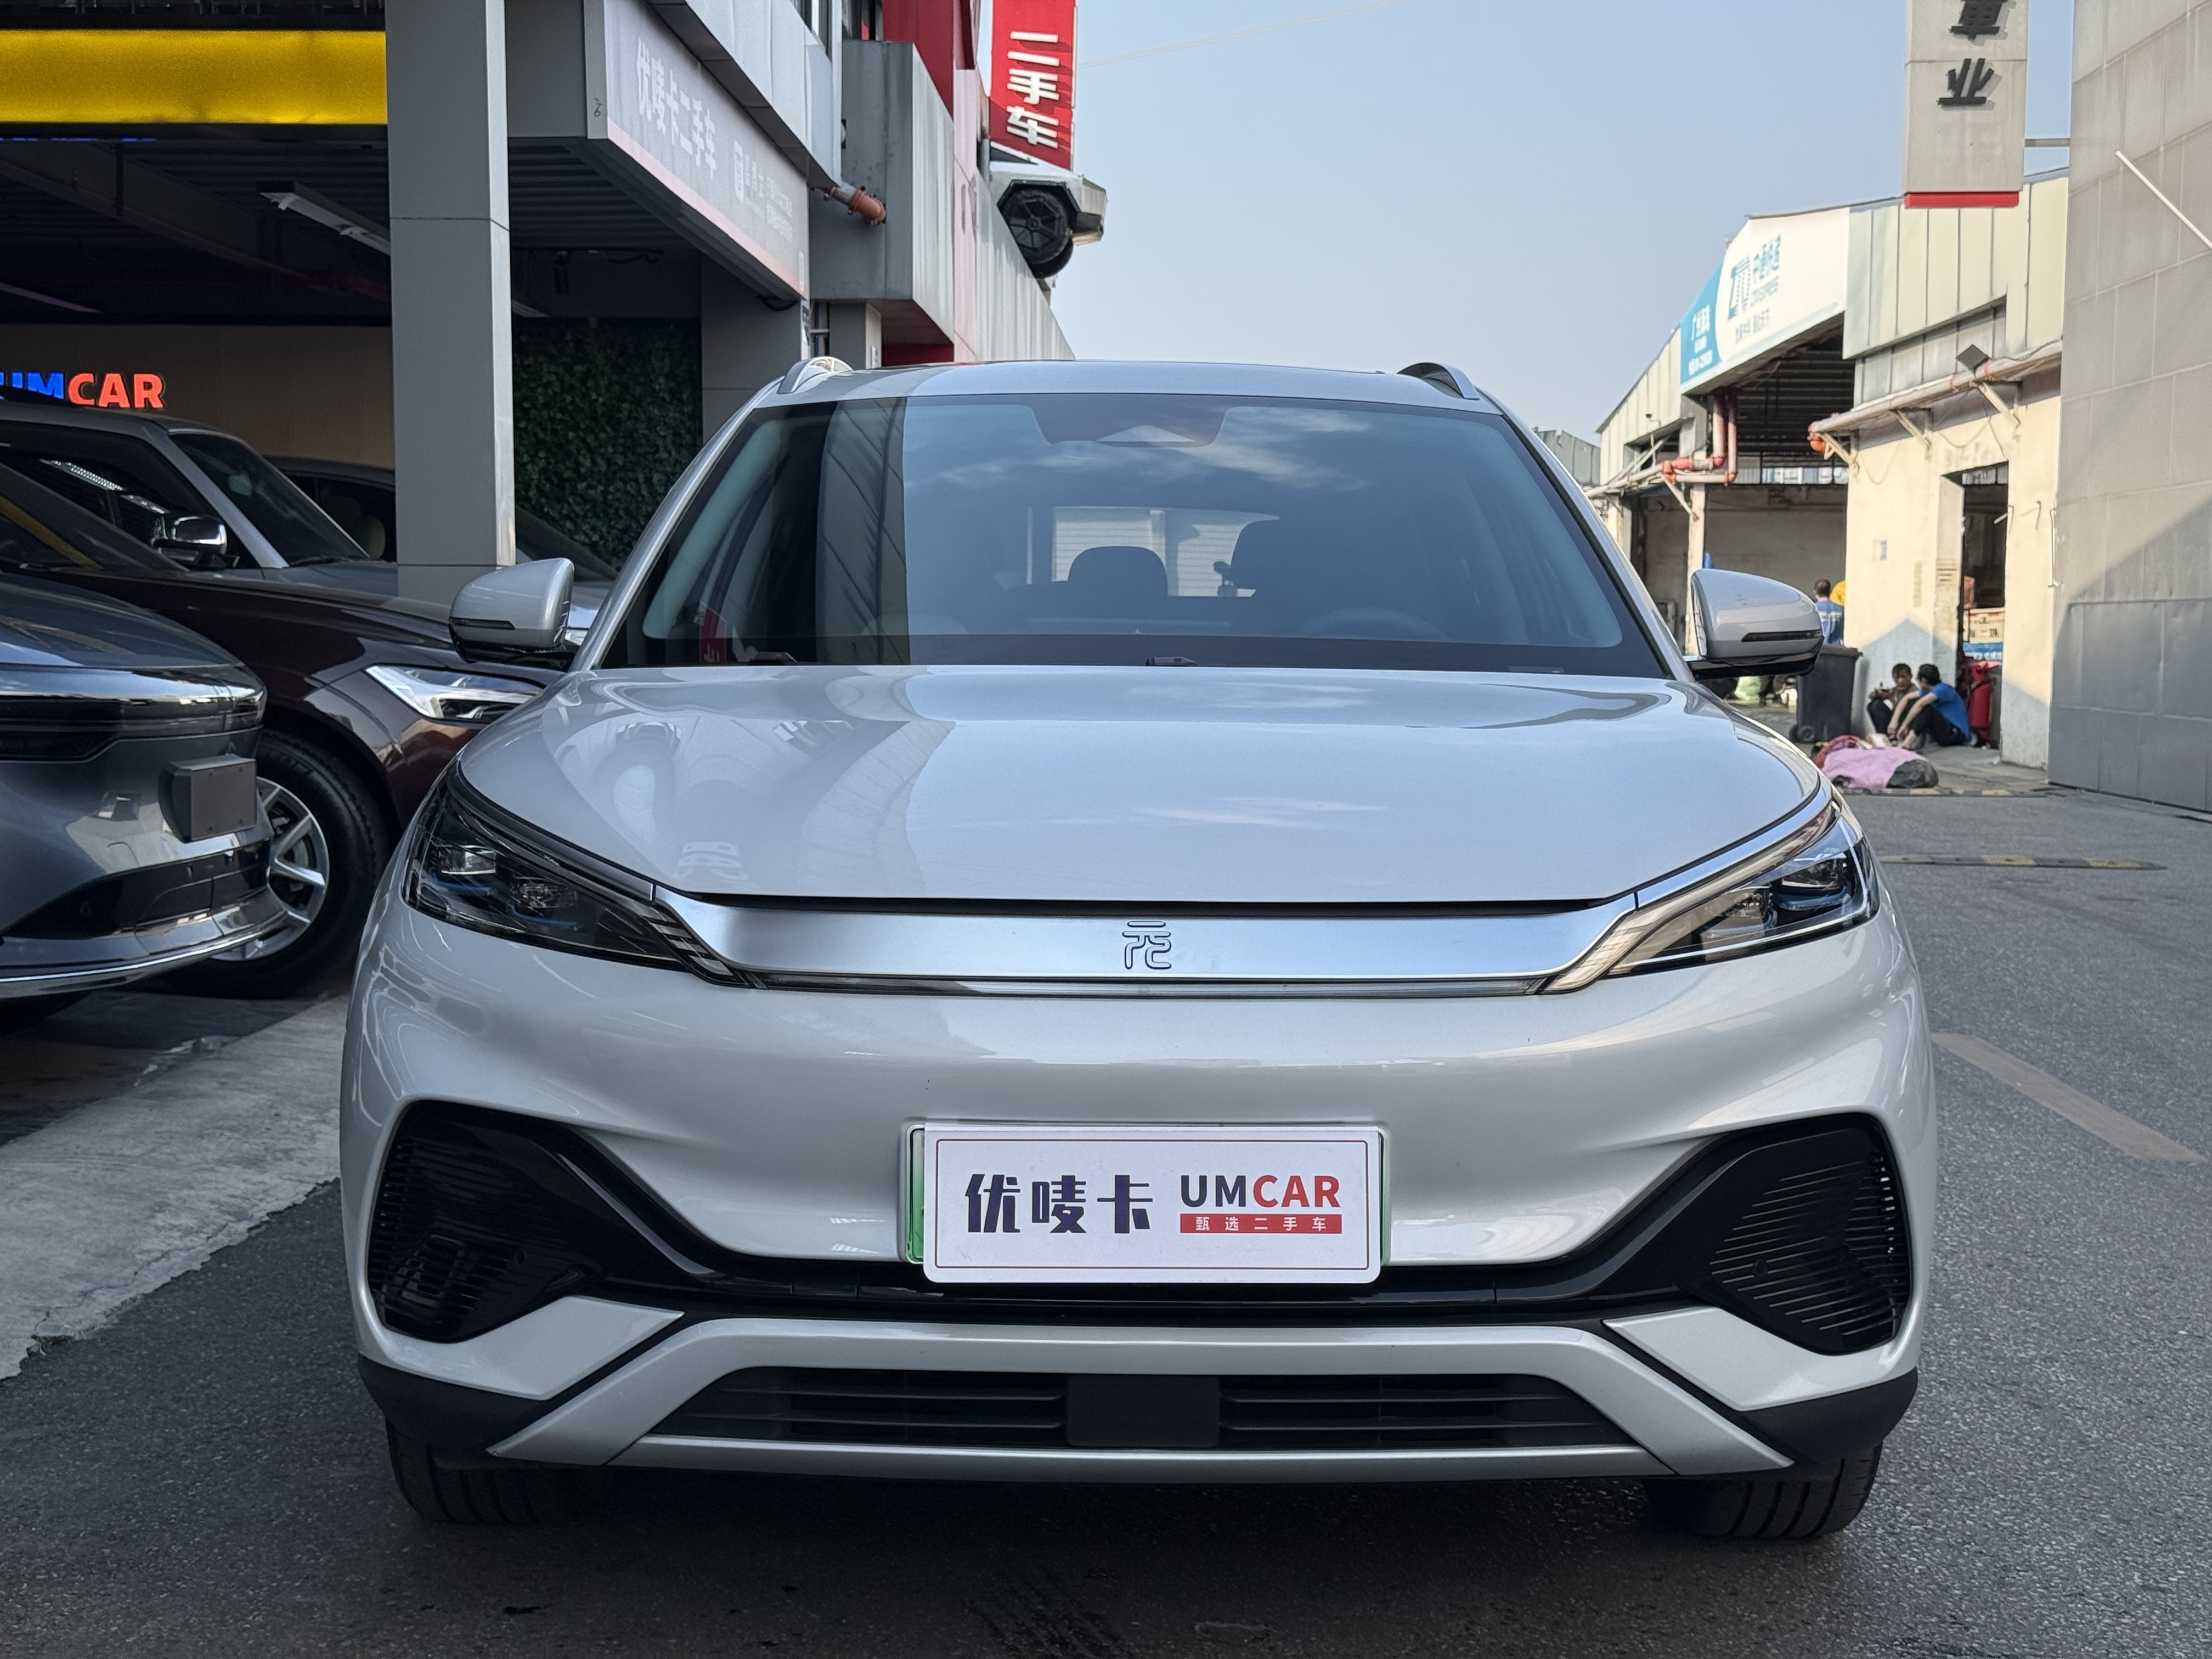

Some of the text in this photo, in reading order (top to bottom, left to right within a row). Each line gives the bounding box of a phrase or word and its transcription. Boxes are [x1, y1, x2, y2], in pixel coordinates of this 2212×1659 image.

[1006, 31, 1060, 149] 二手车
[1122, 921, 1172, 970] 元
[965, 1173, 1153, 1234] 优唛卡
[1180, 1175, 1341, 1208] UMCAR
[1195, 1216, 1327, 1232] 甄选二手车
